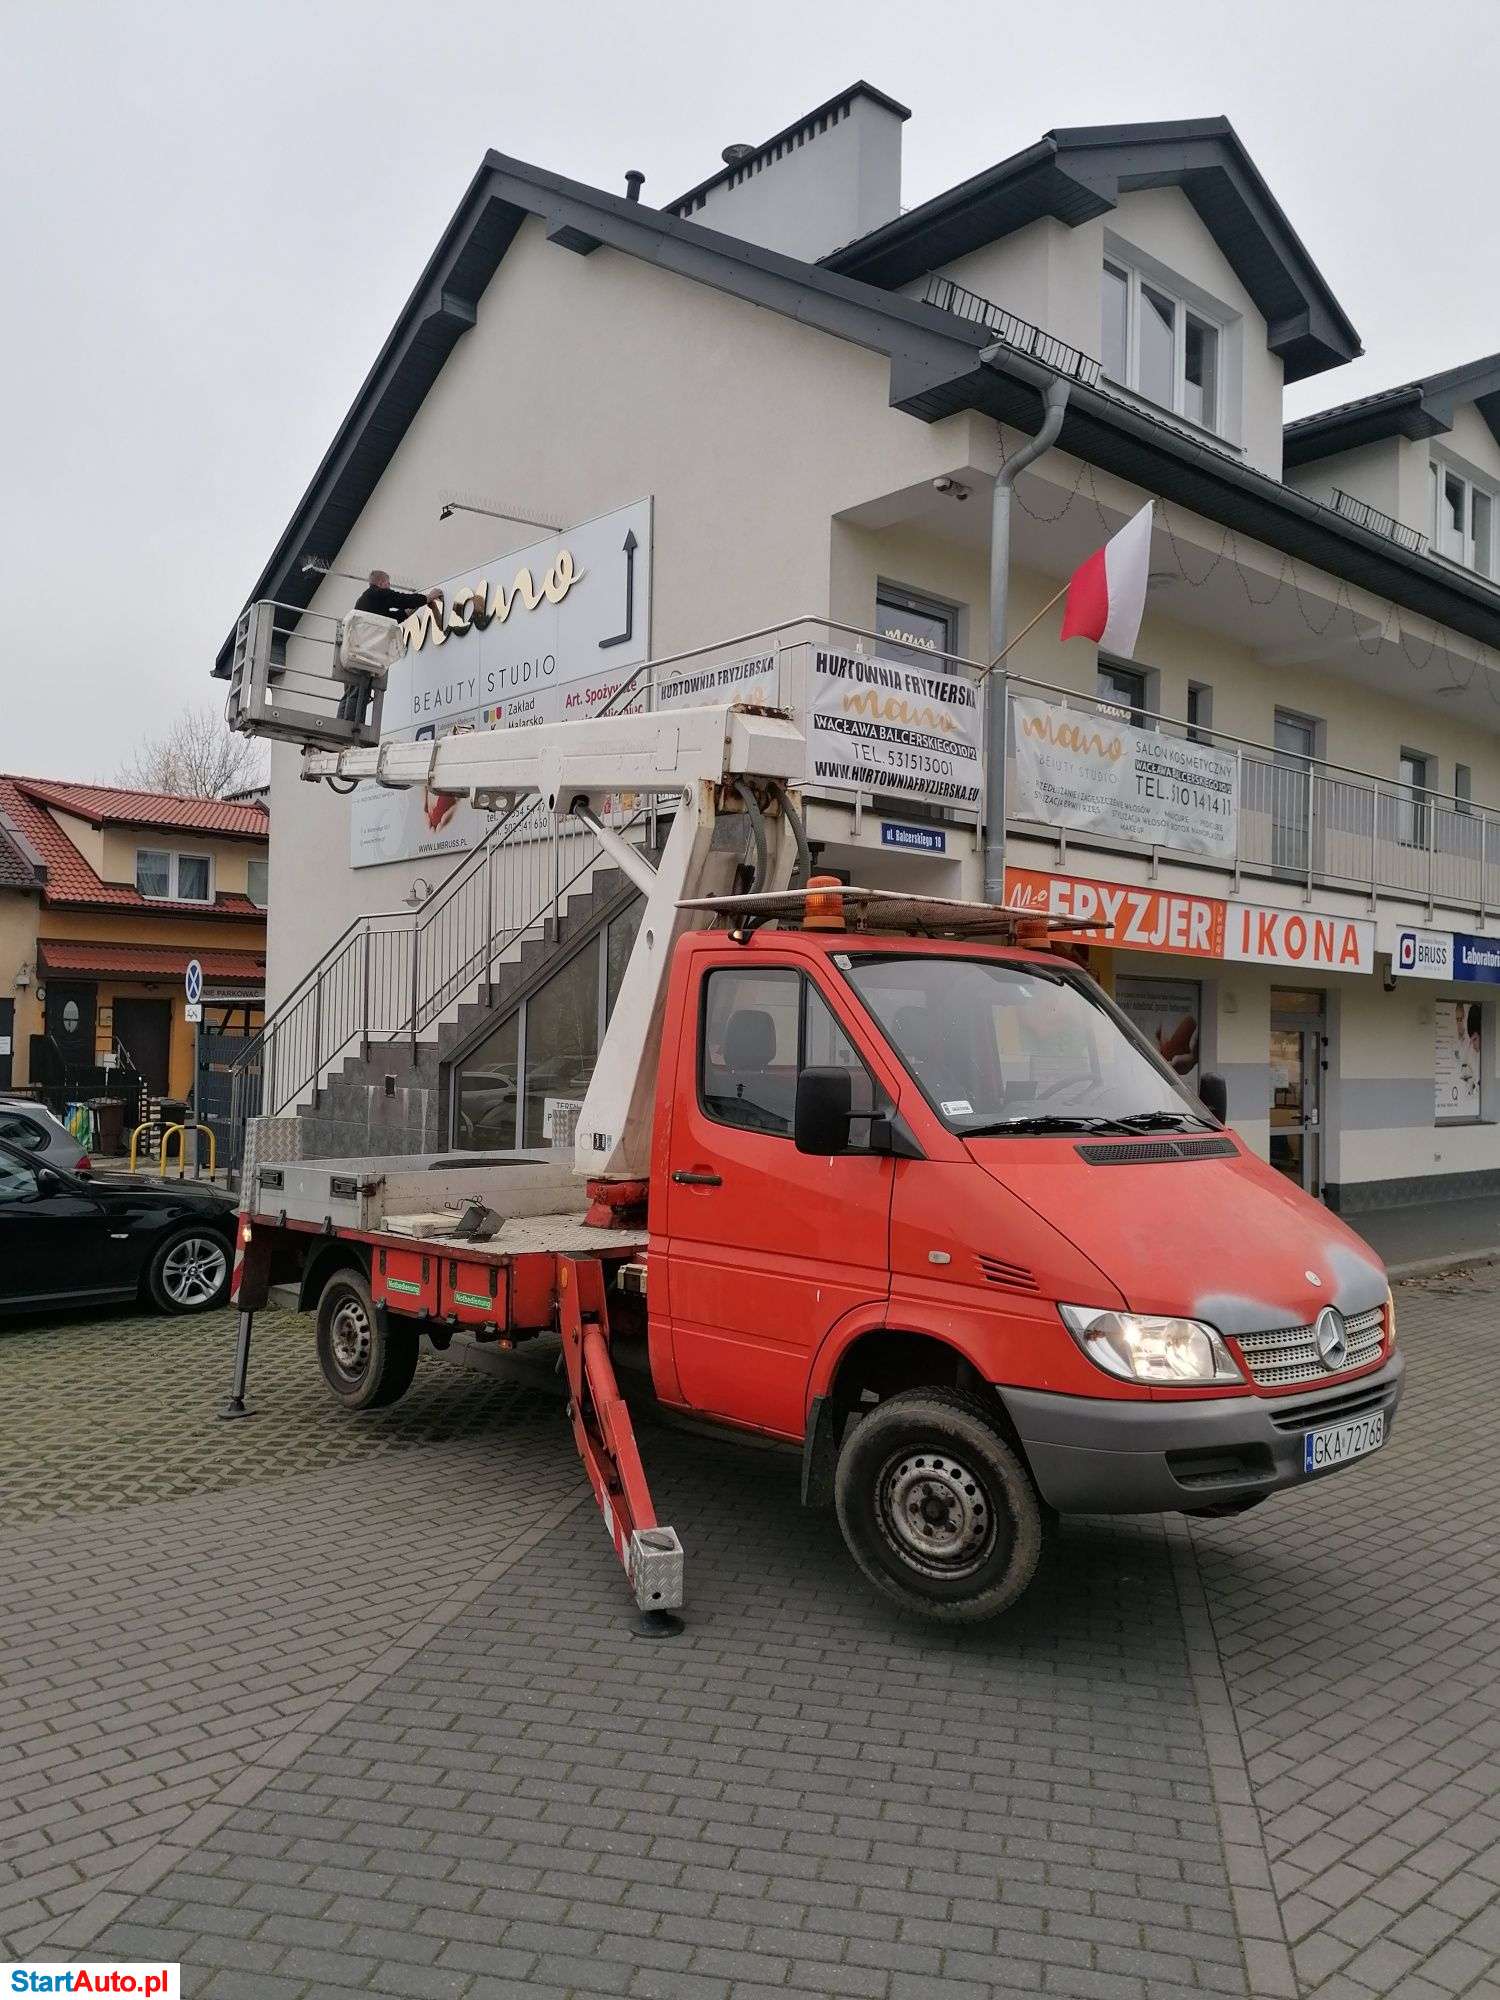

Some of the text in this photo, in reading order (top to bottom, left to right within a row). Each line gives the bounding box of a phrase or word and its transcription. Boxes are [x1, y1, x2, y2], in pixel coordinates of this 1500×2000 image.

[414, 654, 555, 714] BEAUTY STUDIO
[661, 672, 716, 700] HURTOWNIA
[717, 656, 774, 686] FRYZJERSKA
[816, 652, 903, 690] HURTOWNIA
[565, 680, 637, 709] Art. Spożywze
[815, 715, 878, 739] WACŁAWA
[879, 728, 957, 756] BALCERSKIEGO
[852, 741, 954, 776] TEL. 531513001
[1039, 753, 1074, 773] BEUTY
[1136, 775, 1169, 800] TEL.
[895, 829, 933, 847] Balcerskiego
[1049, 879, 1212, 950] FRYZJER
[1241, 909, 1360, 966] IKONA
[1418, 945, 1447, 965] BRUSS
[1314, 1417, 1382, 1464] GKA 72768
